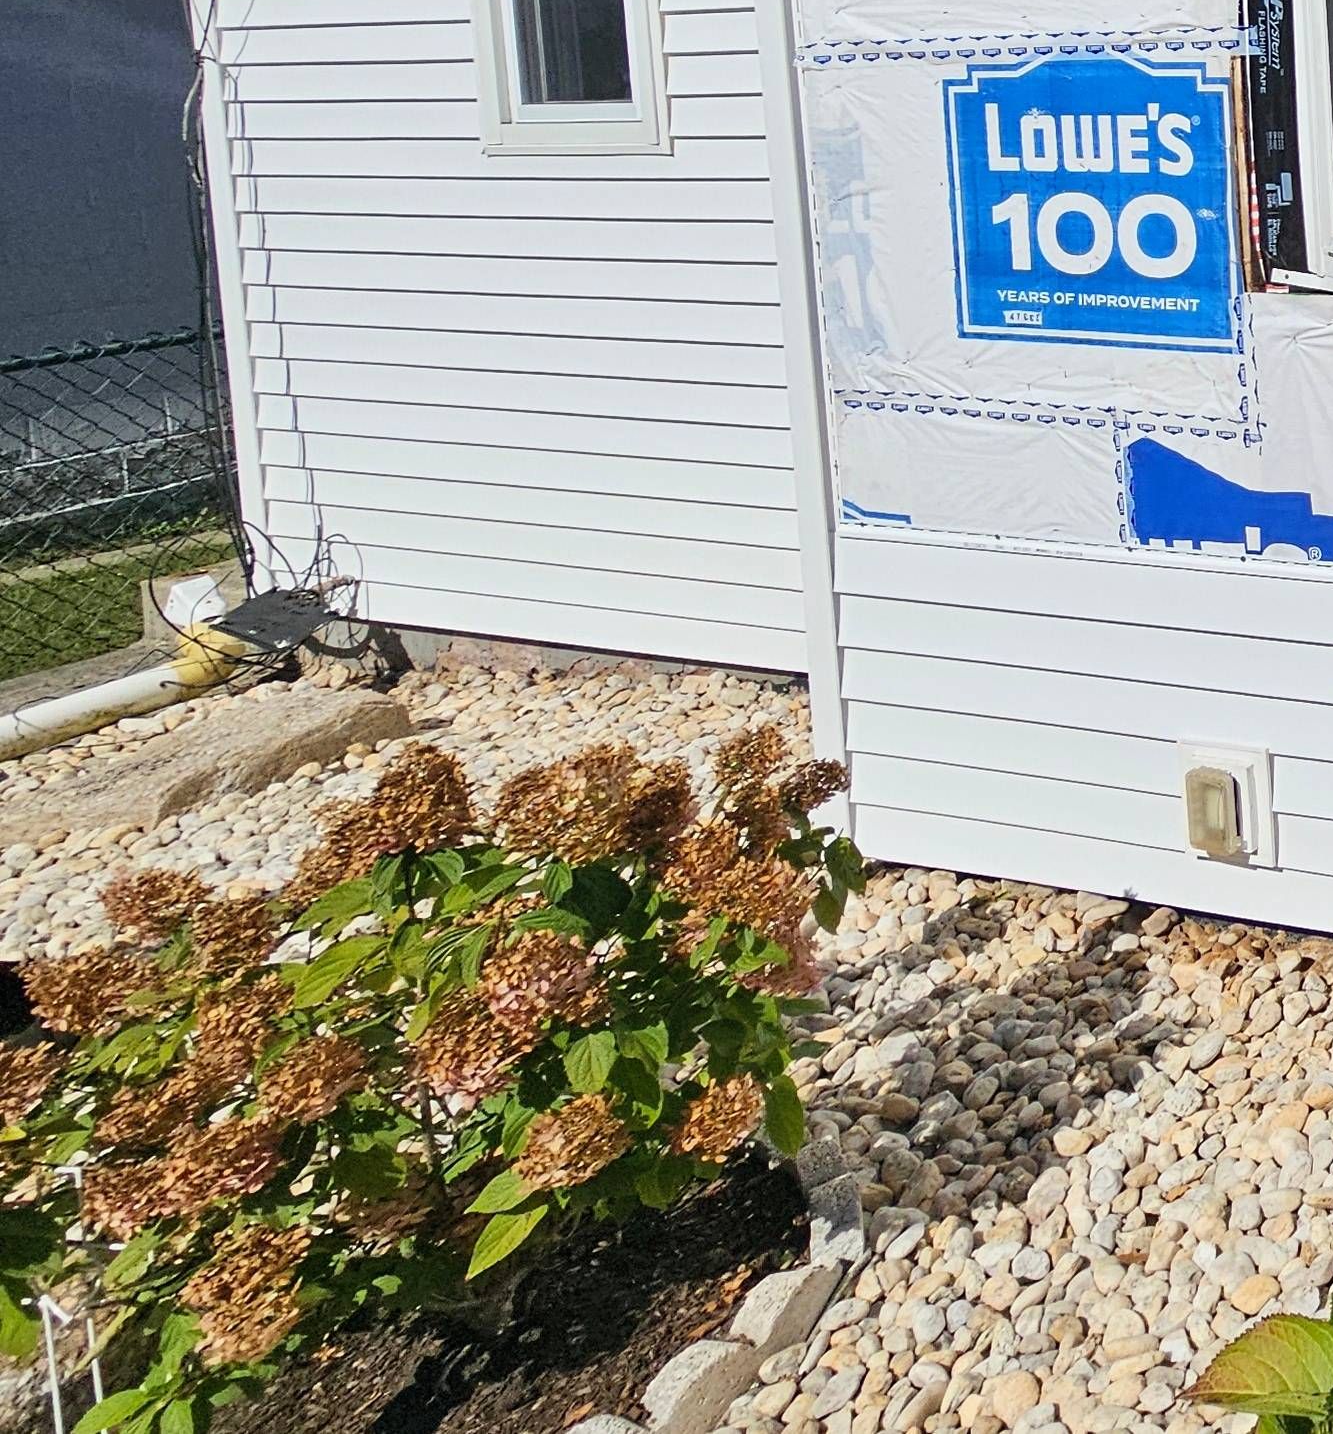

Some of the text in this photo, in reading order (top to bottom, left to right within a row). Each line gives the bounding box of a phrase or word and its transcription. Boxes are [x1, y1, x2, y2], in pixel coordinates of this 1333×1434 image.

[1258, 10, 1267, 94] FLASHING TAPE
[984, 102, 1194, 177] LOWE'S
[991, 192, 1197, 279] 100
[997, 290, 1200, 312] YEARS OF IMPROVEMENT
